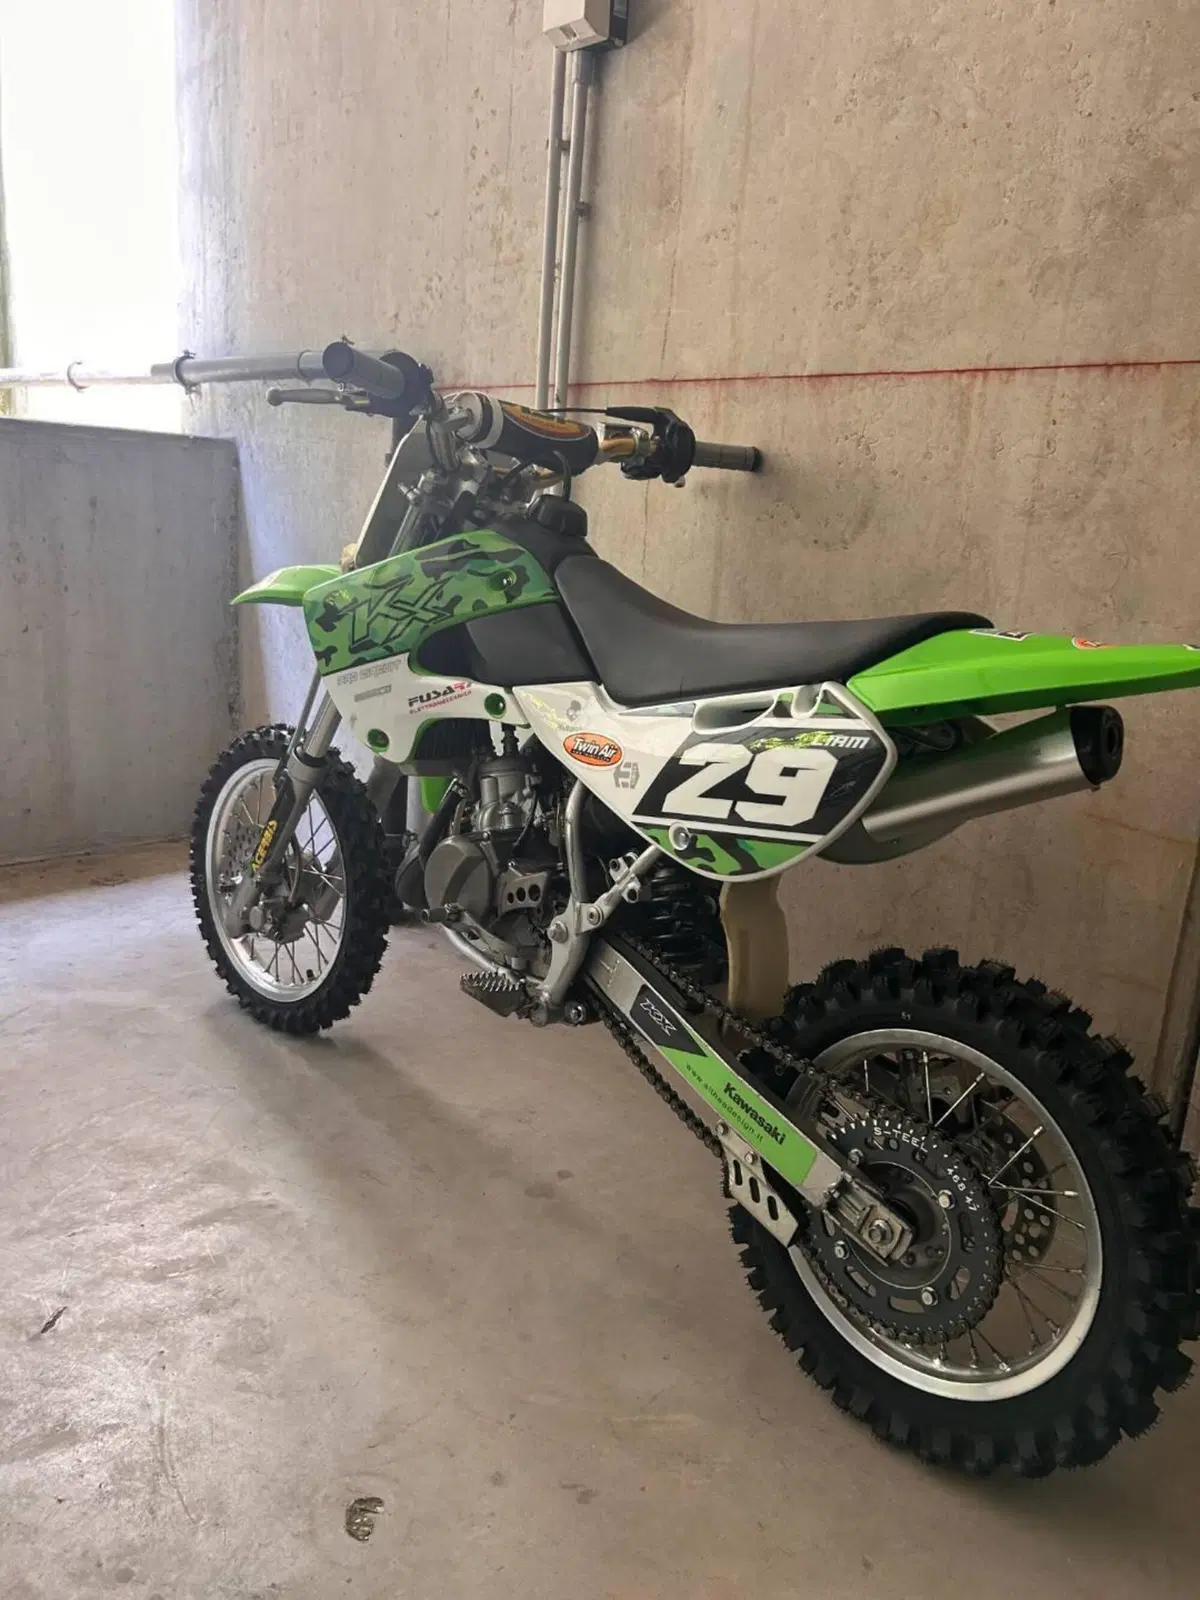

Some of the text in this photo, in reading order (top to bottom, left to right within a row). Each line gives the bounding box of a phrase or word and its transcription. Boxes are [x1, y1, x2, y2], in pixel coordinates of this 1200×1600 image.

[573, 737, 598, 755] Twin
[598, 743, 618, 759] Air
[661, 742, 838, 827] 29
[723, 1082, 787, 1146] Kawasaki
[873, 1126, 929, 1152] S-TEEL
